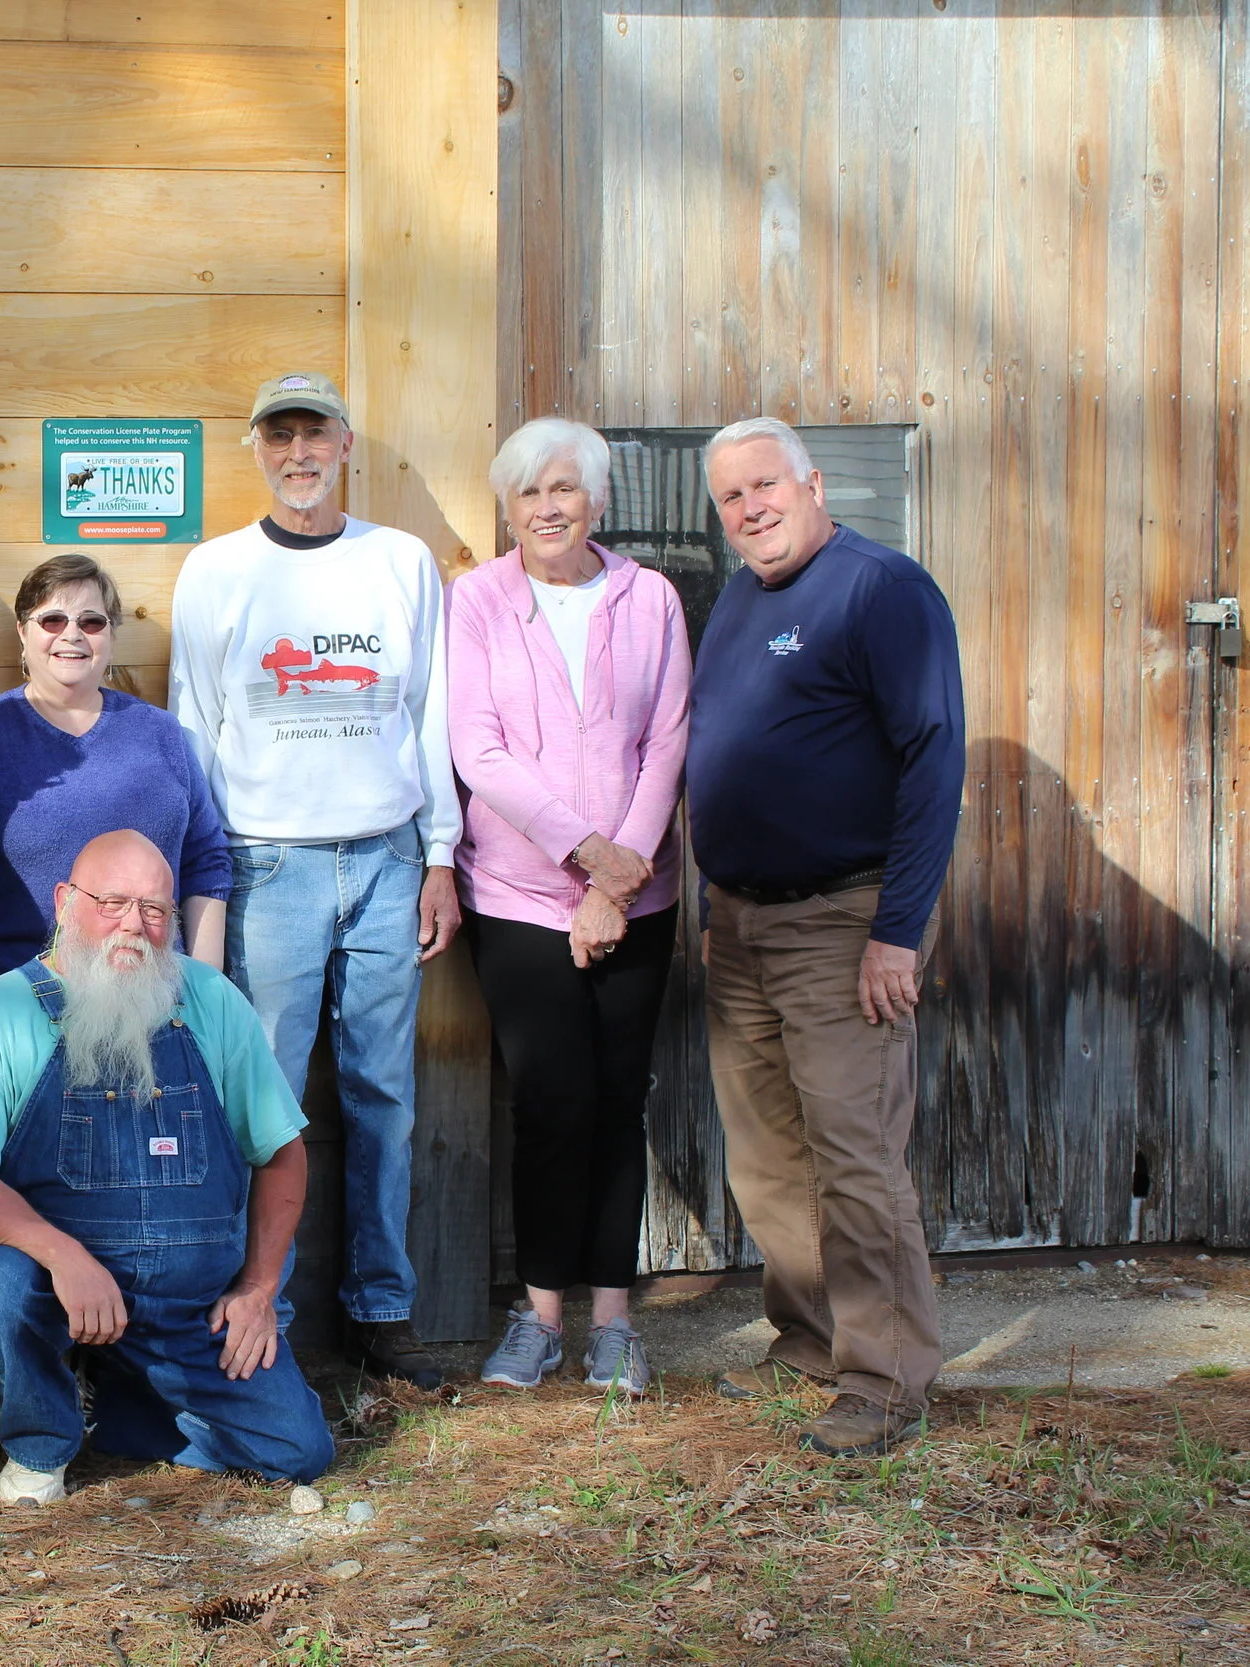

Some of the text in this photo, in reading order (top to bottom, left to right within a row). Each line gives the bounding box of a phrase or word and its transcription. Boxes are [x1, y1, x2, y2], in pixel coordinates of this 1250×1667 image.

[54, 427, 191, 436] The Conservation License Plate Program
[54, 437, 79, 446] helped
[90, 437, 98, 445] to
[132, 437, 145, 445] this
[146, 437, 157, 445] NH
[100, 466, 174, 495] THANKS
[98, 502, 149, 512] HAMPSHIRE
[84, 525, 161, 535] www.mooseplate.com
[312, 633, 382, 655] DIPAC
[272, 724, 381, 743] Juneau, Alasa
